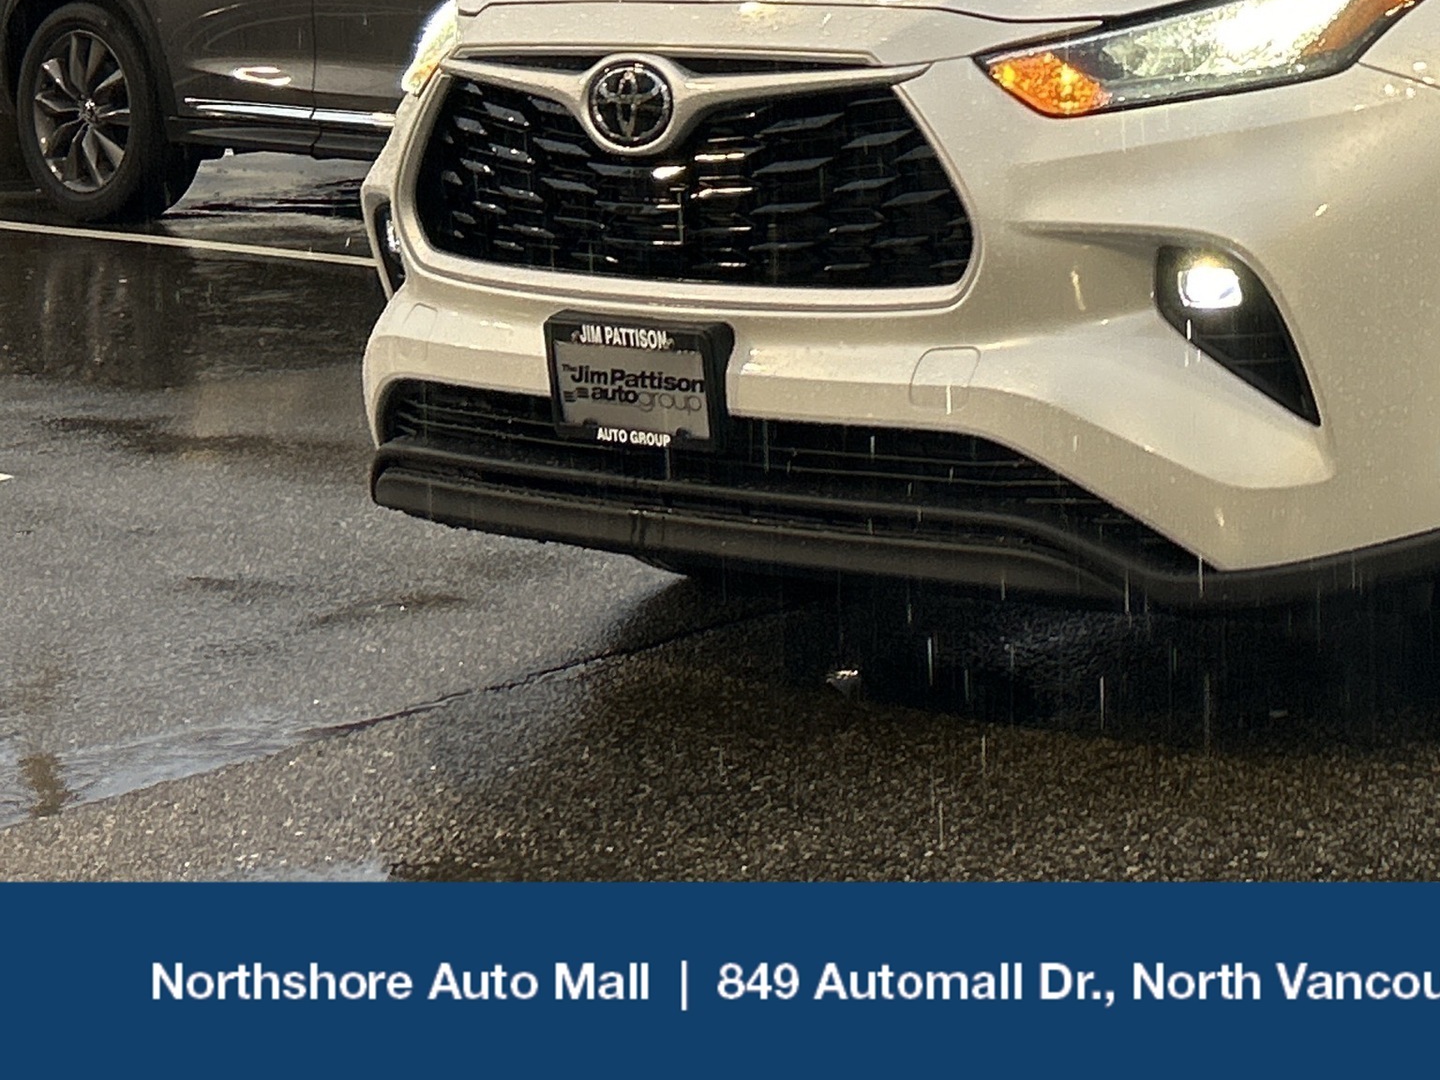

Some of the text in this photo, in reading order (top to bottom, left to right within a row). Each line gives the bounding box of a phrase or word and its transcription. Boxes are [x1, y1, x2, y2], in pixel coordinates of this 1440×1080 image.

[580, 324, 668, 349] JIM PATTISON
[562, 363, 577, 372] The
[597, 427, 671, 447] AUTO GROUP
